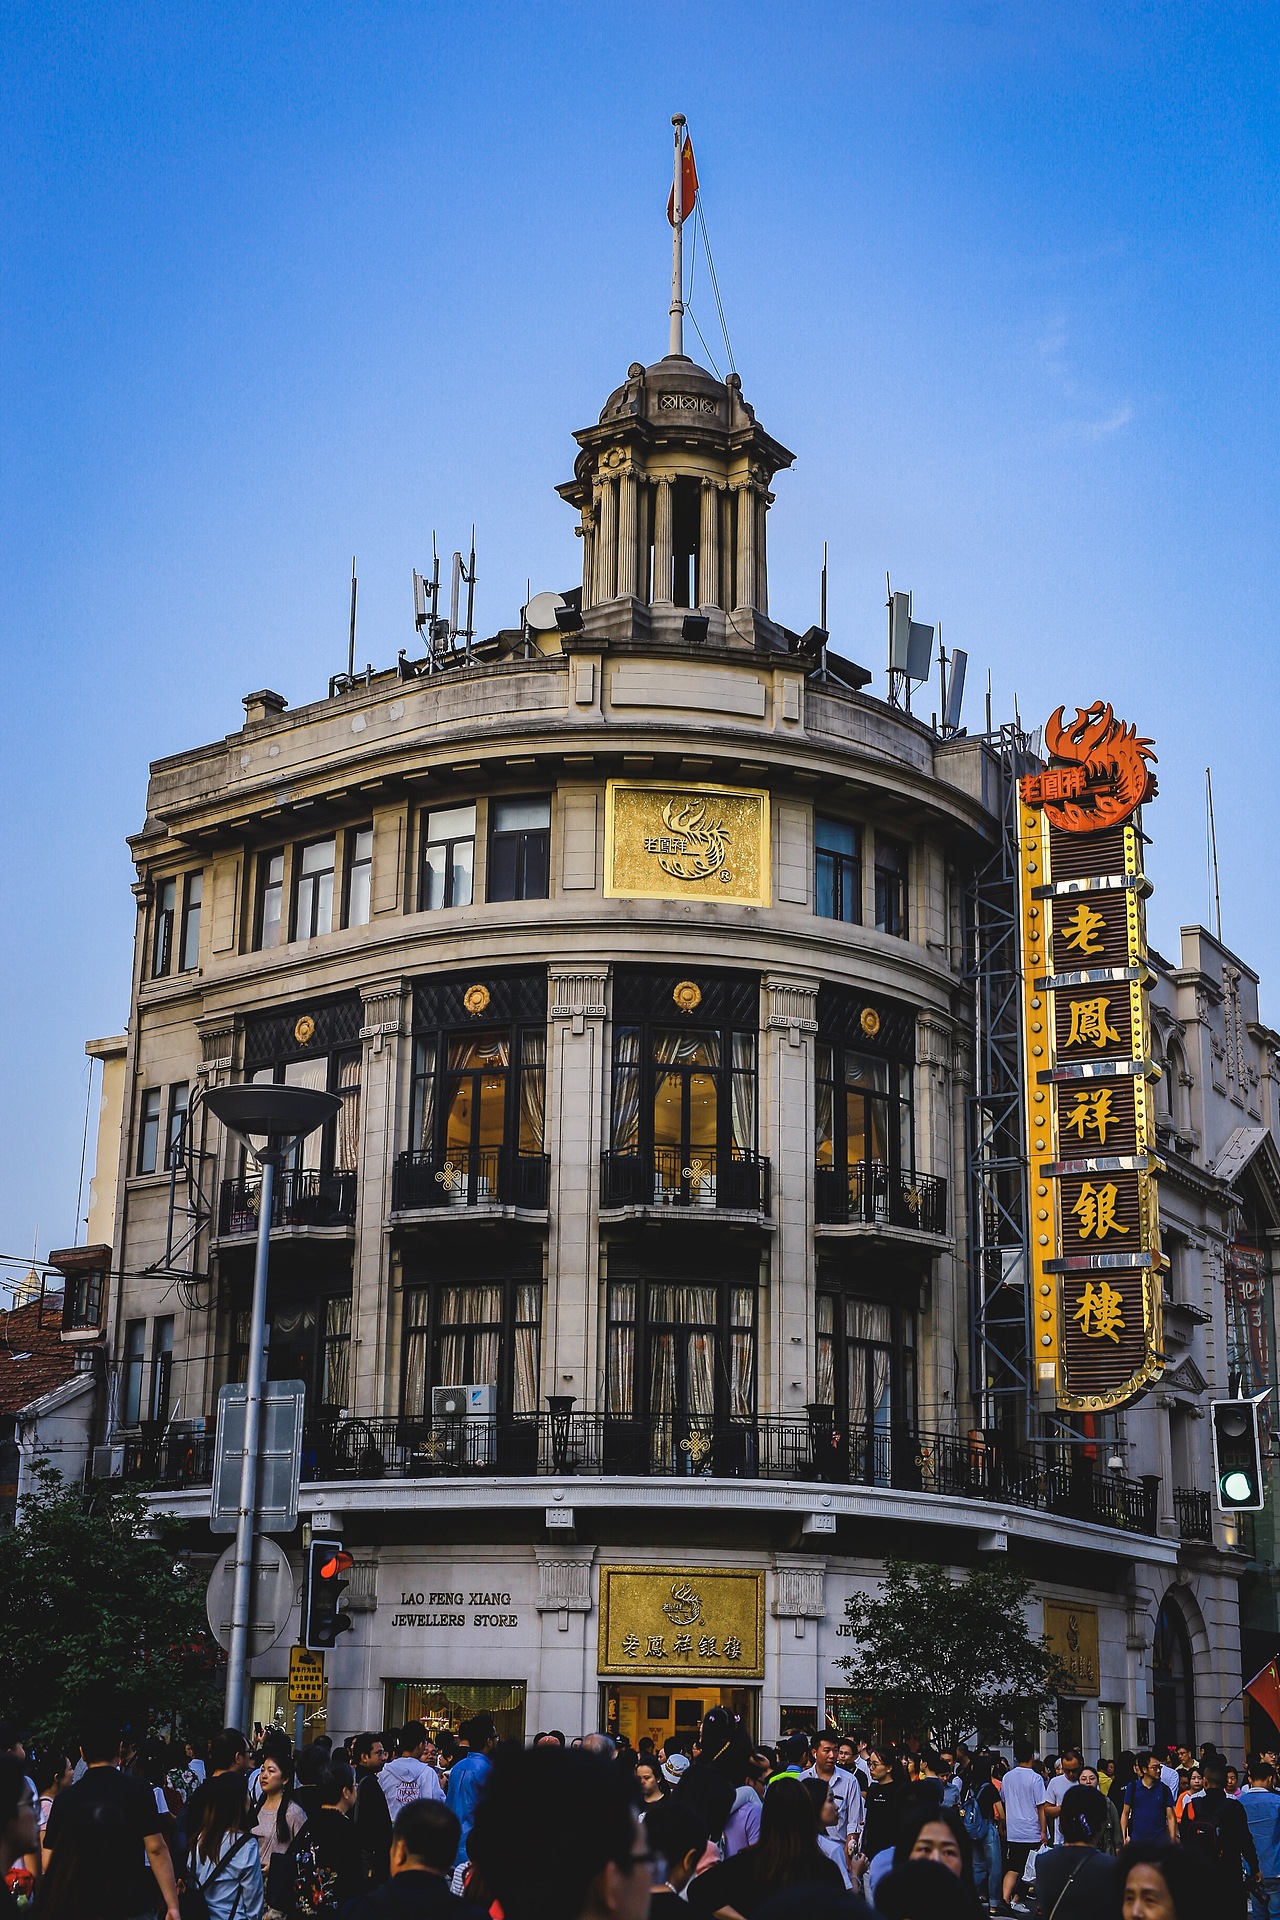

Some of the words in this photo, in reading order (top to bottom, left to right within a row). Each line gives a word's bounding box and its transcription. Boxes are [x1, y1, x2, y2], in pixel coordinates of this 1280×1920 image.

[1061, 904, 1130, 1344] 老鳳祥銀樓
[401, 1593, 424, 1605] LAO
[429, 1593, 464, 1605] FENG
[468, 1593, 511, 1605] XIANG
[392, 1614, 465, 1627] JEWELLERS
[474, 1614, 518, 1627] STORE
[622, 1632, 743, 1661] 老鳳祥銀樓
